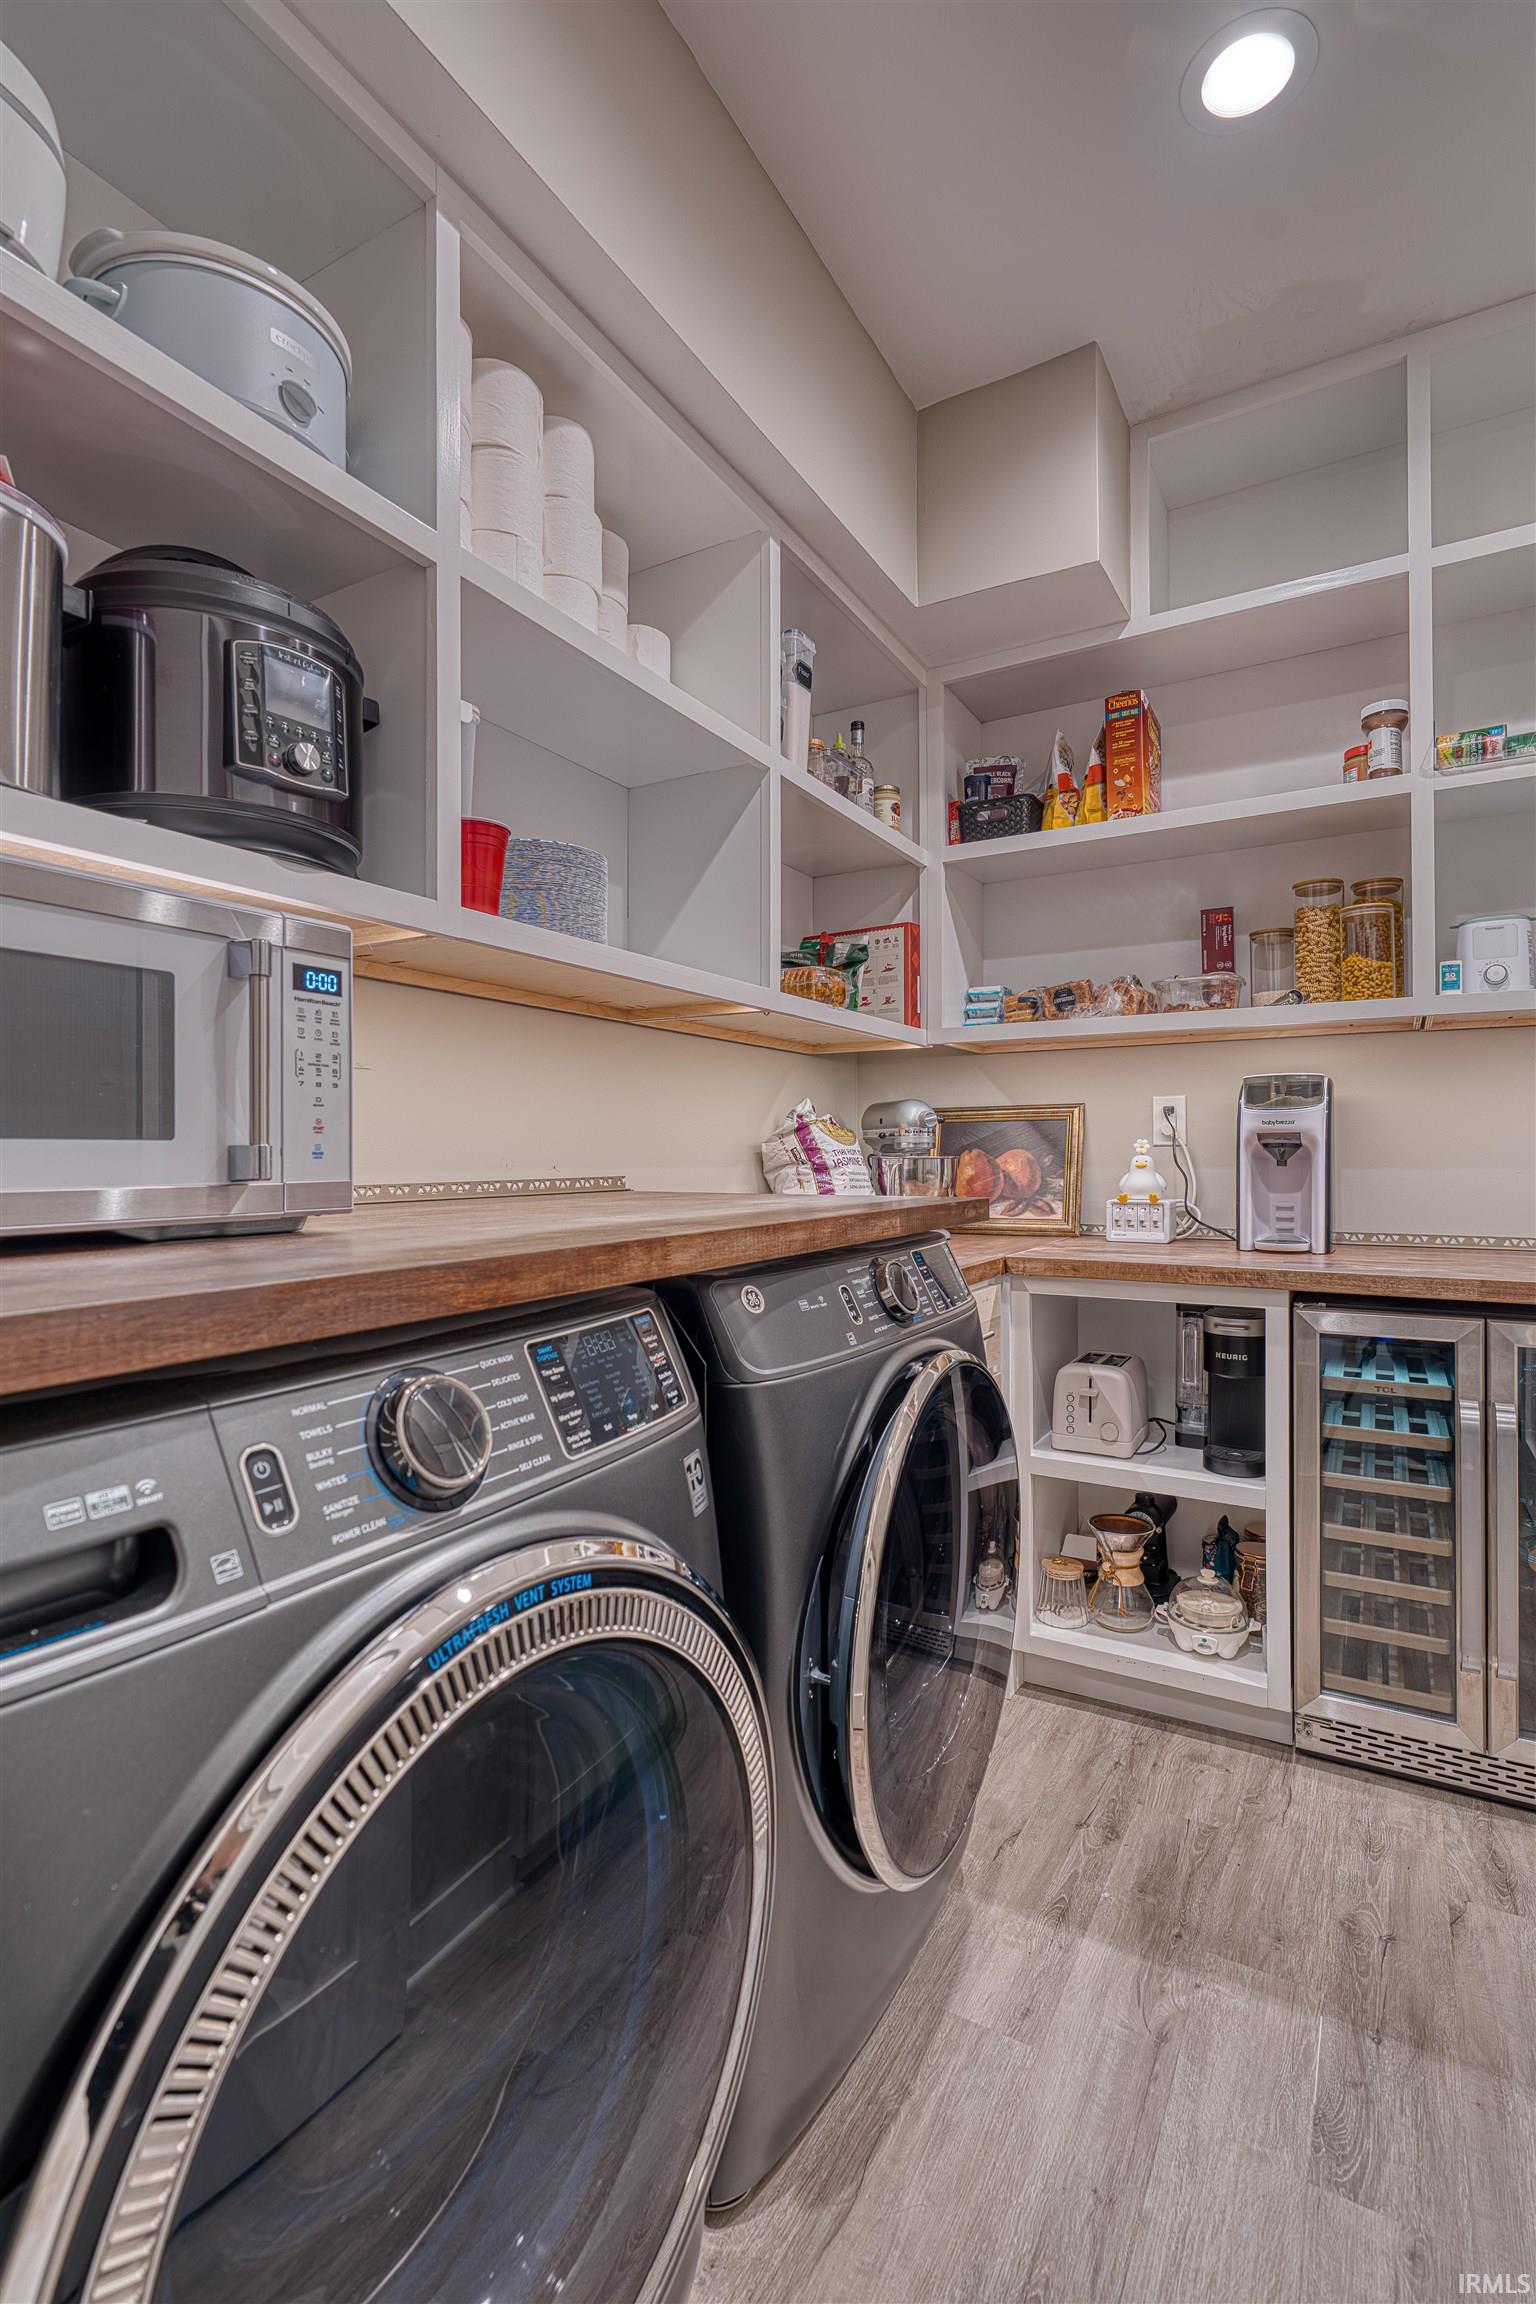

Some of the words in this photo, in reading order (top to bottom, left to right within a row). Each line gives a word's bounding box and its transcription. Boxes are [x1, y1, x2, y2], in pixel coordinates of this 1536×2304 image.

[1108, 698, 1139, 710] Cheerios
[1221, 924, 1229, 947] Spaghetti
[306, 971, 337, 992] 0:00
[294, 996, 321, 1005] Hamilton
[832, 1157, 863, 1168] JASMINE
[479, 1359, 497, 1370] QUICK
[497, 1354, 514, 1365] WASH
[1215, 1351, 1248, 1361] KEURIG
[491, 1372, 521, 1387] DELICATES
[1374, 1386, 1397, 1394] TCL
[291, 1401, 328, 1417] NORMAL
[496, 1399, 512, 1409] COLD
[511, 1393, 529, 1404] WASH
[500, 1417, 520, 1431] ACTIVE
[519, 1412, 535, 1424] WEAR
[299, 1424, 334, 1440] TOWELS
[507, 1440, 525, 1452] RINSE
[529, 1433, 544, 1444] SPIN
[305, 1447, 333, 1463] BULKY
[519, 1461, 532, 1472] SELF
[533, 1453, 552, 1466] CLEAN
[314, 1473, 348, 1492] WHITES
[322, 1494, 360, 1514] SANITIZE
[331, 1526, 361, 1545] POWER
[361, 1517, 387, 1533] CLEAN
[427, 1603, 510, 1671] ULTRAFRESH
[513, 1584, 545, 1611] VENT
[551, 1573, 593, 1597] SYSTEM
